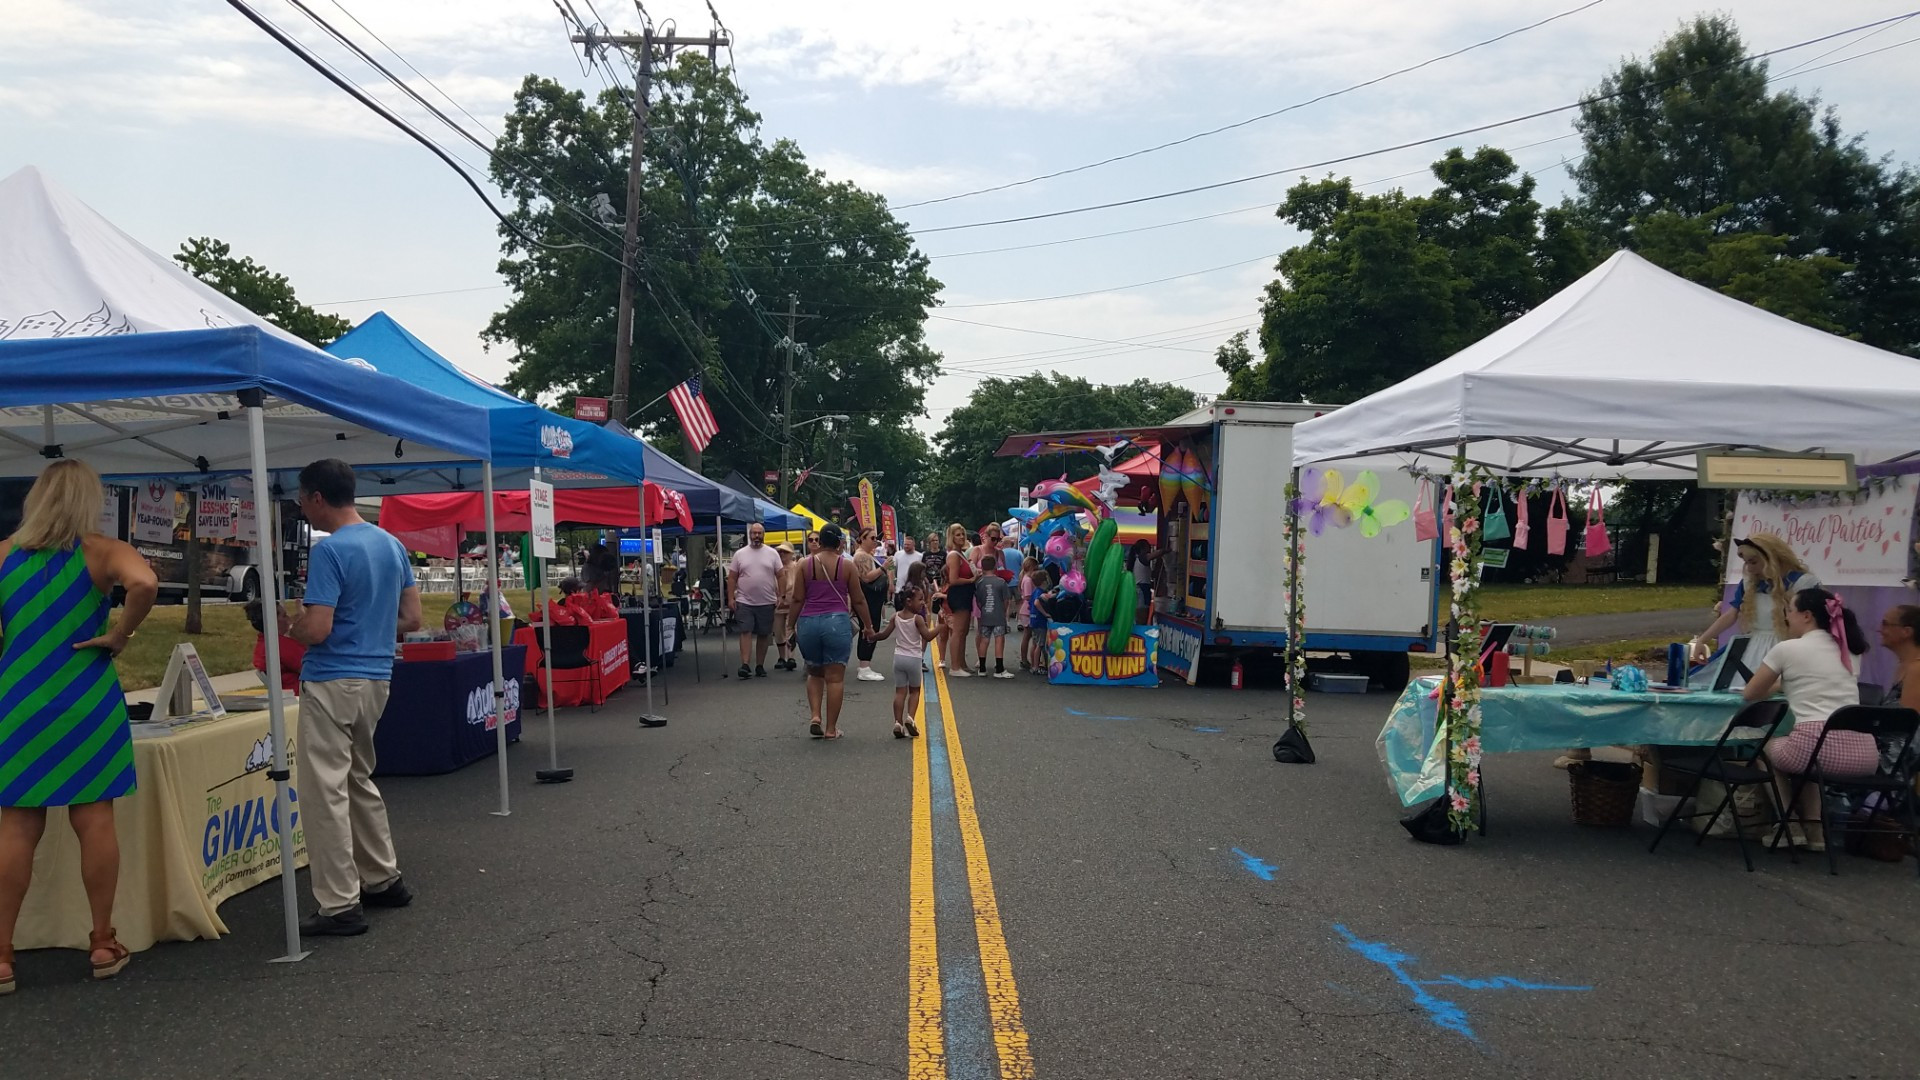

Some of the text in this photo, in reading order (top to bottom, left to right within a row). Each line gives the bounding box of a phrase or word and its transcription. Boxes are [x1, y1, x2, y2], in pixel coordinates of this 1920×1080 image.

[202, 485, 227, 500] SWIM
[535, 488, 548, 502] STAGE
[200, 501, 229, 514] LESSONS
[241, 500, 255, 510] SAFET
[199, 516, 229, 527] SAVE LIVES
[1787, 516, 1828, 545] Petal
[1829, 514, 1884, 544] Parties
[1072, 634, 1105, 652] PLAY
[1127, 637, 1145, 653] TIL
[1072, 655, 1145, 677] YOU WIN!
[243, 847, 258, 864] OF
[266, 855, 281, 868] and
